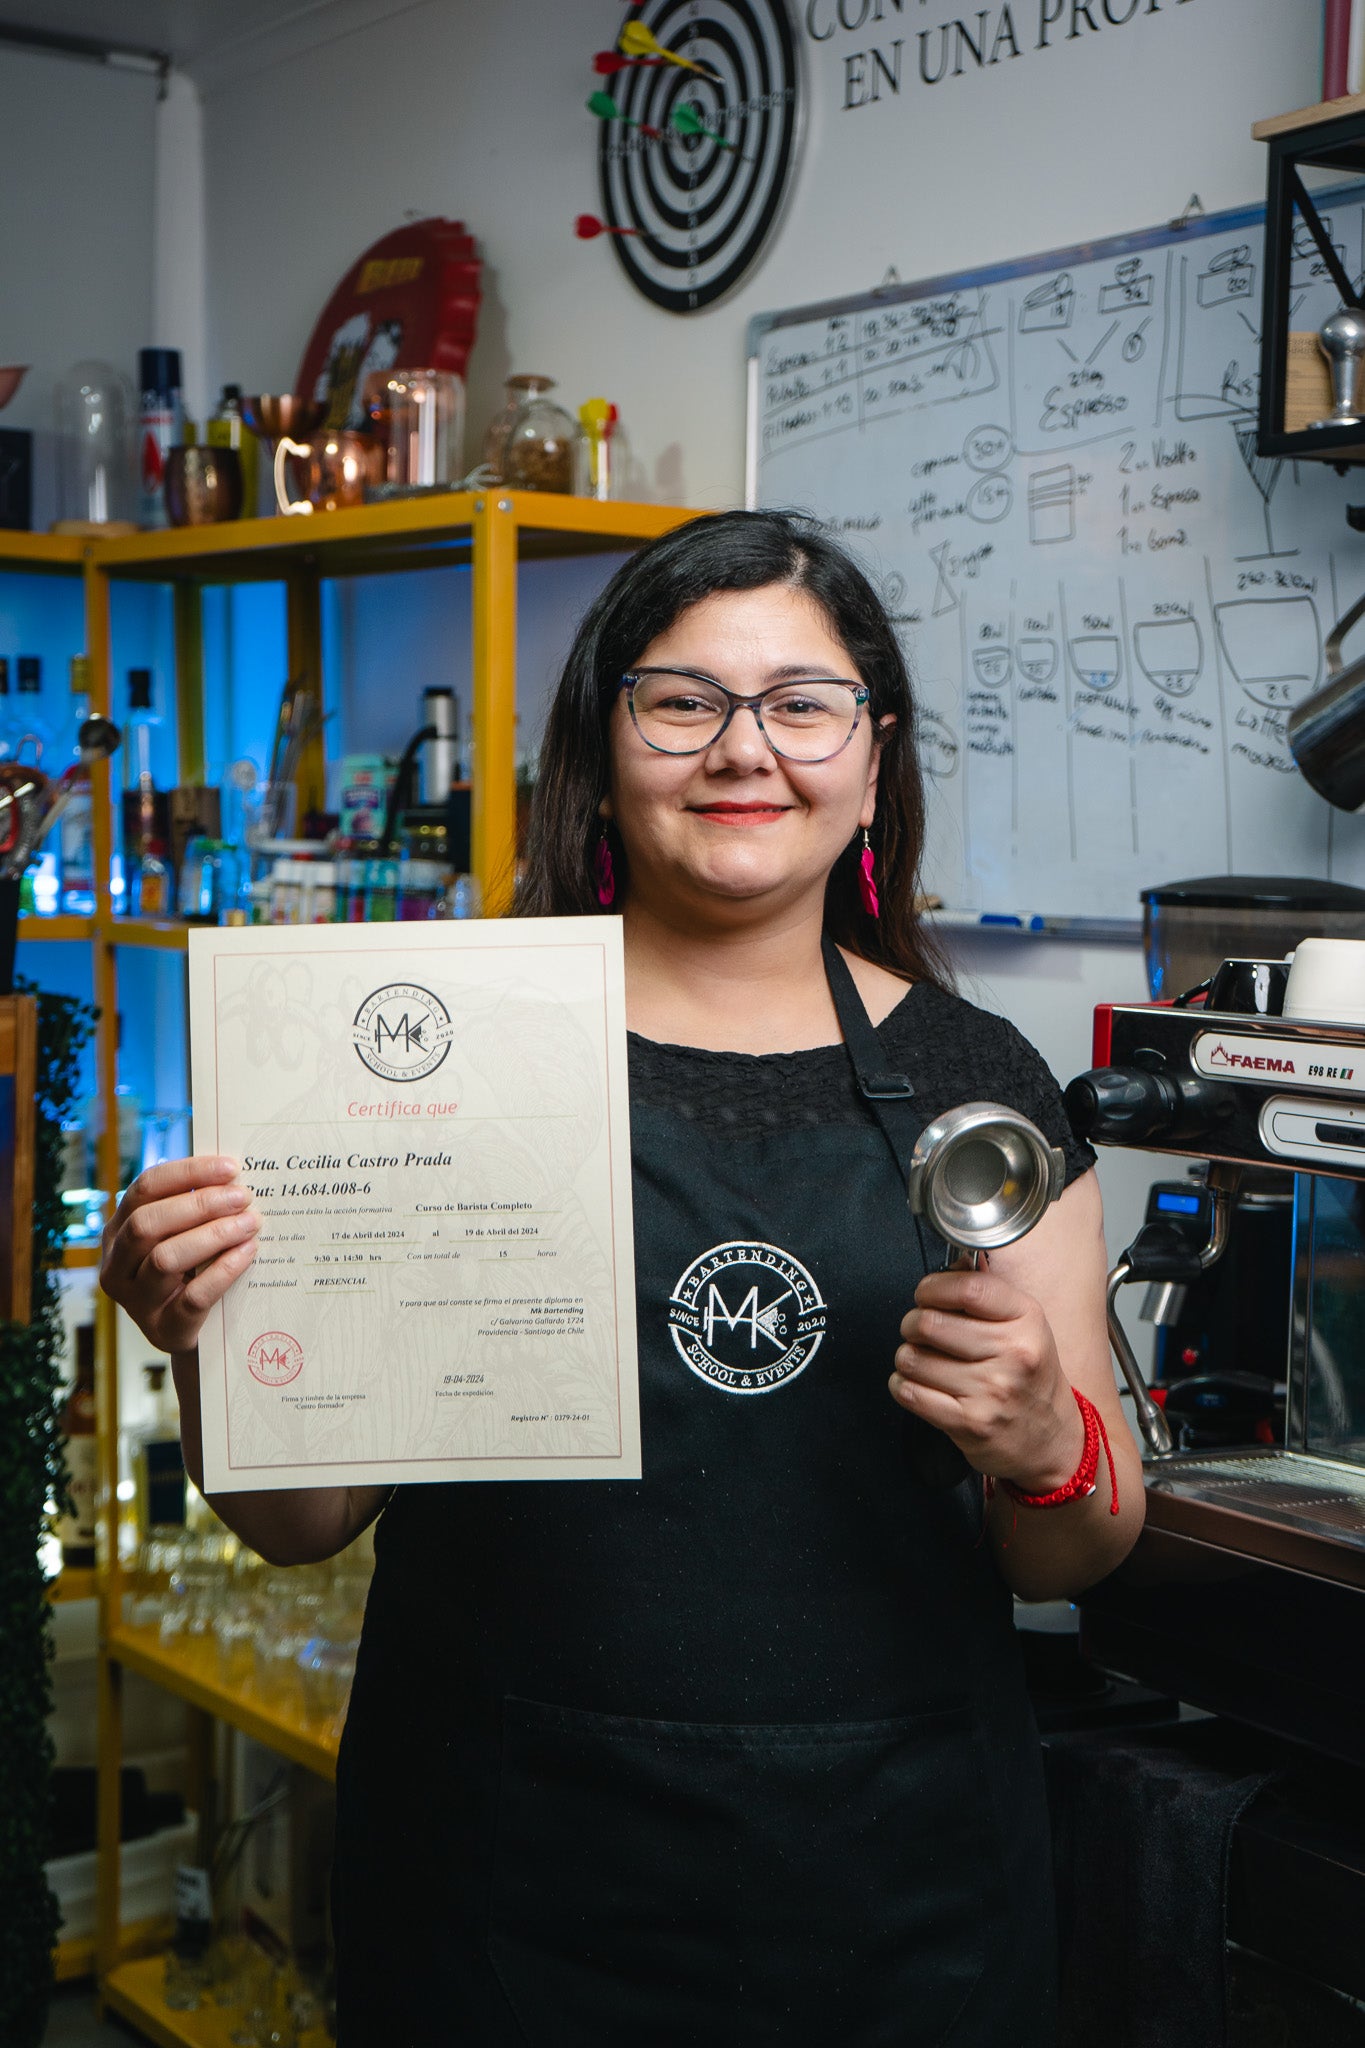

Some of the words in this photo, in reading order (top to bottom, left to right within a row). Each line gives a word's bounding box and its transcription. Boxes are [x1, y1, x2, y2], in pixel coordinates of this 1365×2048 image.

[841, 39, 904, 111] EN
[916, 3, 1024, 84] UNA
[1040, 385, 1128, 433] Espresso
[365, 988, 440, 1013] BARTENDING
[366, 1053, 398, 1077] SCHOOL
[411, 1053, 441, 1076] EVENTS
[1230, 1054, 1295, 1074] FAEMA
[1308, 1065, 1324, 1077] E98
[1326, 1067, 1338, 1078] RE
[347, 1101, 421, 1118] Certifica
[427, 1102, 458, 1118] que
[242, 1156, 280, 1171] Srta.
[286, 1154, 341, 1170] Cecilia
[347, 1154, 399, 1169] Castro
[404, 1152, 452, 1167] Prada
[281, 1181, 371, 1197] 14.684.008-6
[306, 1207, 323, 1215] éxito
[333, 1207, 357, 1215] acción
[357, 1206, 393, 1217] formativa
[415, 1203, 442, 1212] Curso
[444, 1203, 455, 1212] de
[457, 1202, 488, 1211] Barista
[490, 1202, 533, 1213] Completo
[290, 1233, 306, 1241] días
[331, 1232, 340, 1240] 17
[341, 1232, 351, 1240] de
[374, 1231, 386, 1239] del
[387, 1230, 405, 1238] 2024
[465, 1228, 473, 1236] 19
[475, 1228, 485, 1236] de
[486, 1228, 507, 1236] Abril
[521, 1227, 539, 1235] 2024
[314, 1255, 330, 1263] 9:30
[343, 1254, 364, 1262] 14:30
[407, 1252, 421, 1260] Con
[434, 1251, 451, 1260] total
[451, 1251, 461, 1259] de
[499, 1250, 508, 1258] 15
[537, 1249, 557, 1257] horas
[258, 1256, 285, 1265] horario
[286, 1256, 296, 1264] de
[688, 1249, 807, 1291] BARTENDING
[248, 1280, 259, 1289] En
[259, 1279, 297, 1288] modalidad
[314, 1277, 368, 1286] PRESENCIAL
[424, 1300, 437, 1308] que
[483, 1298, 503, 1307] firma
[512, 1298, 543, 1307] presente
[544, 1297, 573, 1306] diploma
[543, 1307, 584, 1316] Bartending
[499, 1317, 533, 1325] Galvarino
[534, 1317, 565, 1325] Gallardo
[670, 1308, 700, 1327] SINCE
[797, 1316, 826, 1332] 2020
[477, 1328, 518, 1336] Providencia
[524, 1328, 556, 1337] Santiago
[567, 1327, 585, 1335] Chile
[686, 1343, 737, 1386] SCHOOL
[741, 1374, 752, 1387] &
[756, 1345, 807, 1386] EVENTS
[443, 1374, 485, 1384] 19-04-2024
[462, 1389, 494, 1398] expedición
[511, 1414, 539, 1423] Registro
